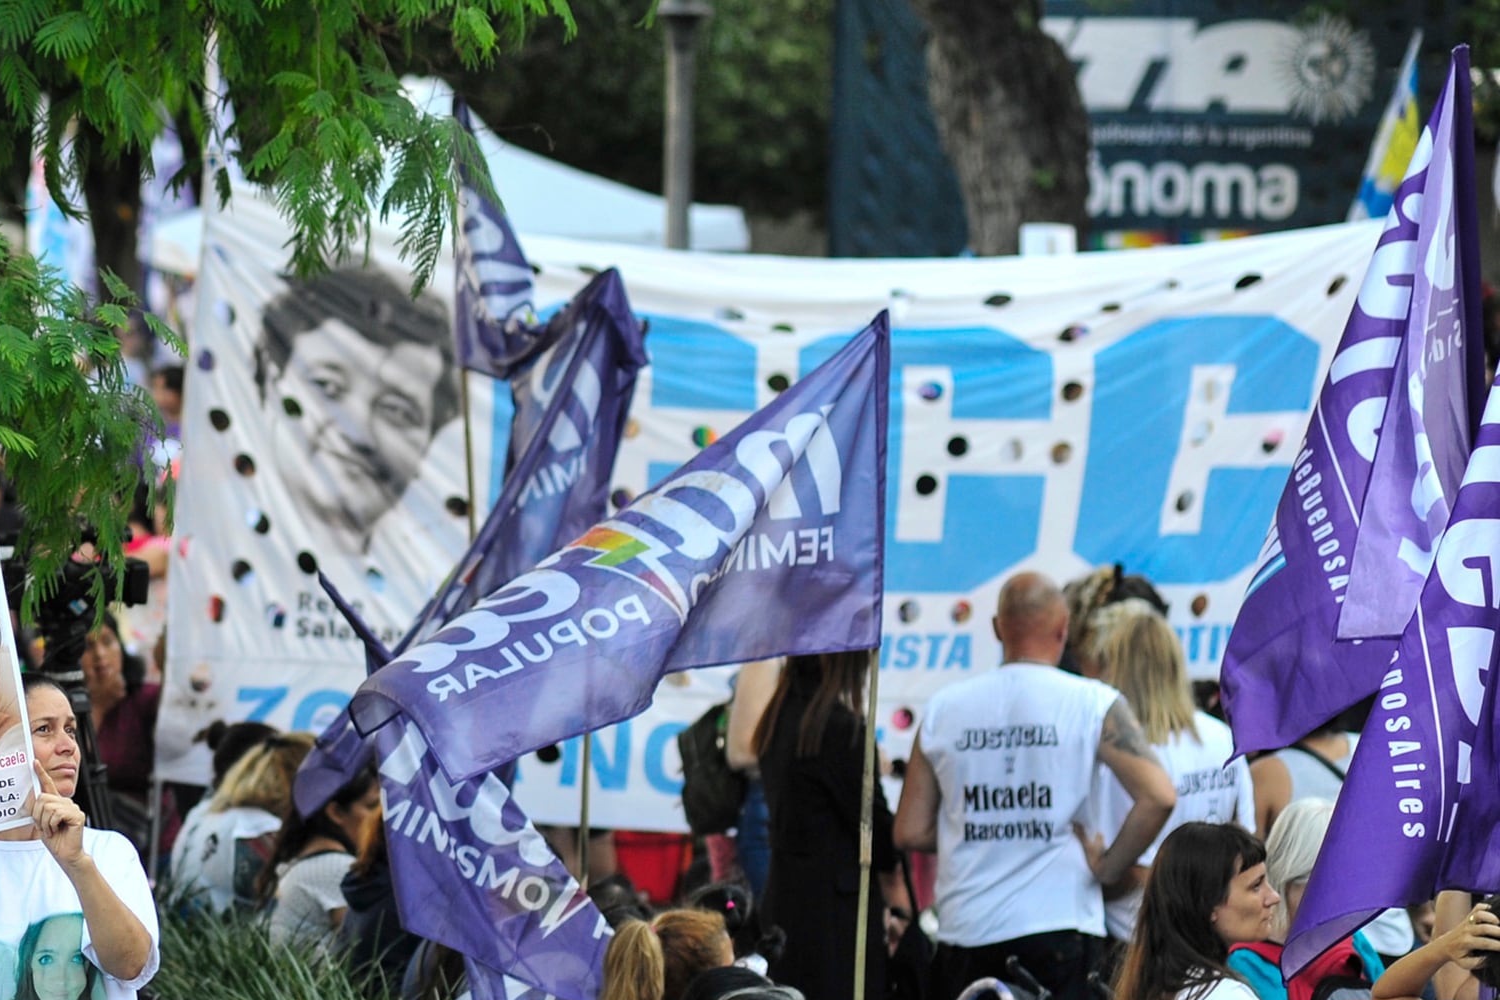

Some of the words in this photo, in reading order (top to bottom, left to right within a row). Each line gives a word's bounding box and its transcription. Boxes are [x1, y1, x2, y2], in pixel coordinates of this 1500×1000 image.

[956, 725, 1058, 750] JUSTICIA
[963, 781, 1052, 812] Micaela
[964, 820, 1054, 843] Rascovsky
